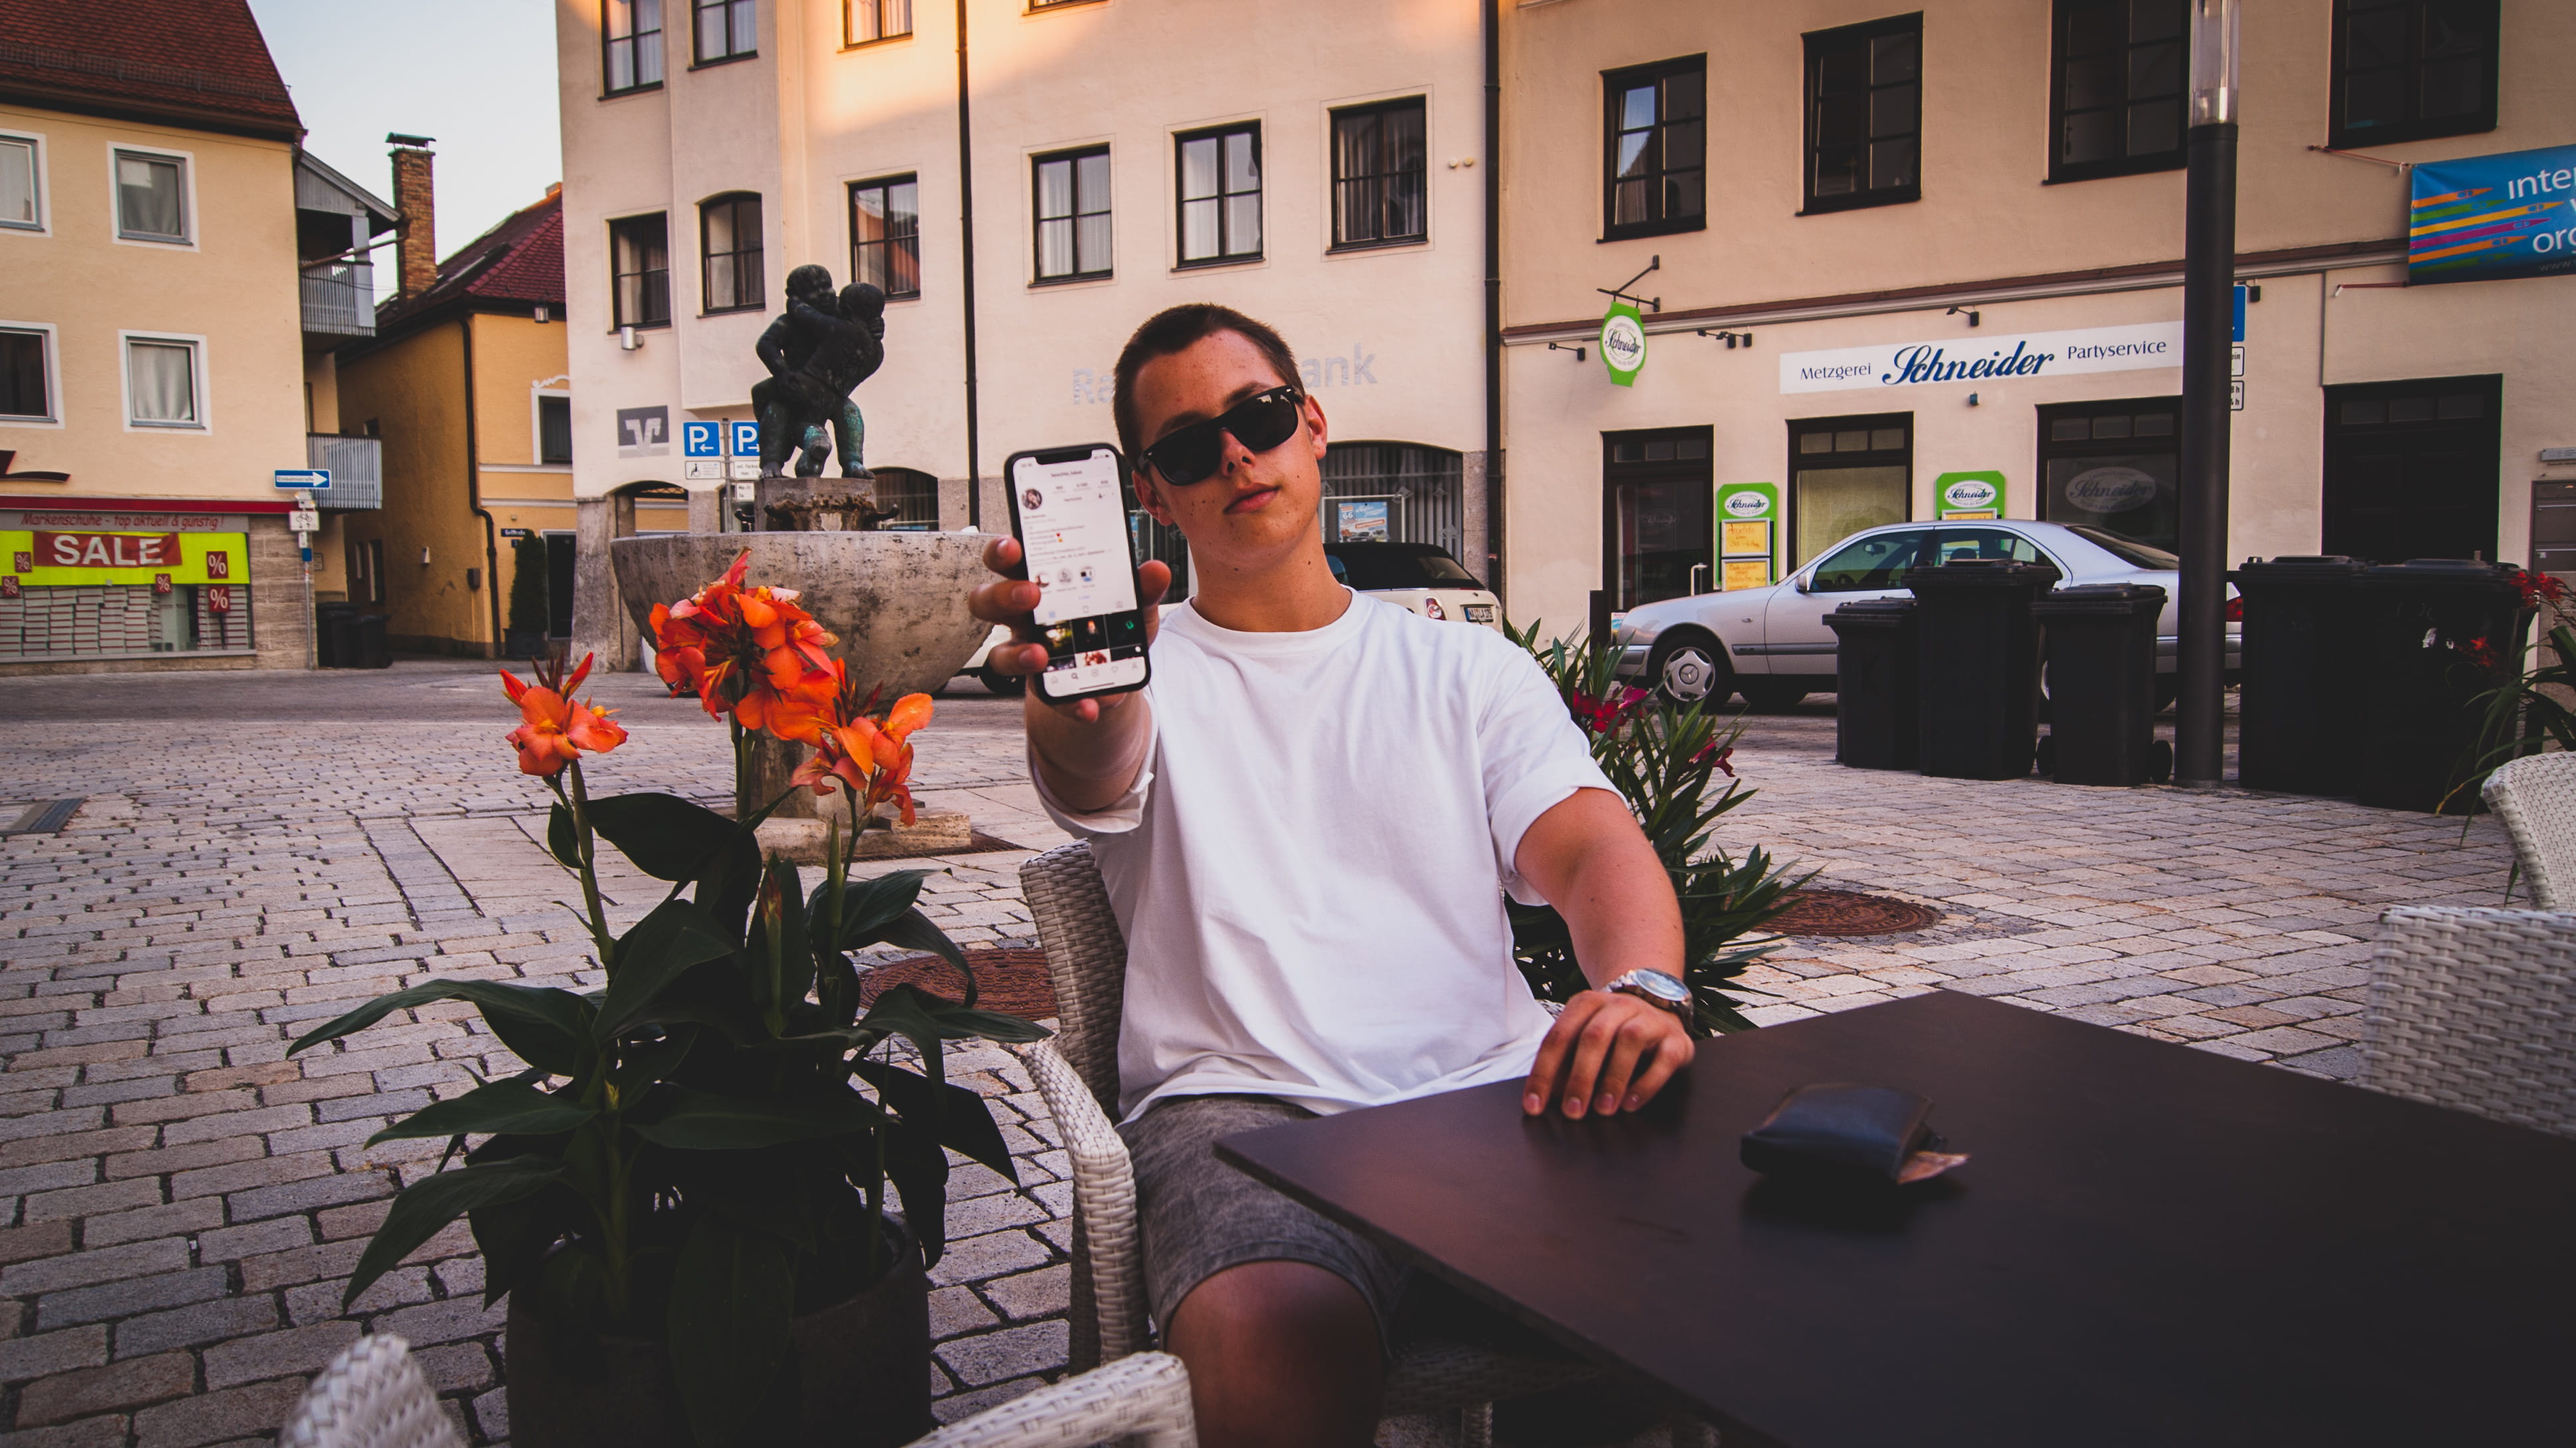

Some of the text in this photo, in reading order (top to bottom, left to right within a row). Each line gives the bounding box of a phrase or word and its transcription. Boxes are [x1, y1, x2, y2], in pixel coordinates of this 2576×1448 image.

[2508, 167, 2576, 200] inte
[1605, 328, 1641, 354] Schneider
[1800, 340, 2167, 385] Metzgerei Schneider Partyservice
[689, 426, 709, 452] P
[738, 426, 757, 452] P
[1947, 488, 1993, 498] Schneider
[2069, 479, 2153, 498] Schneider
[1726, 498, 1767, 509] Schneider
[21, 512, 102, 526] Markenschuhe
[114, 515, 130, 528] top
[134, 515, 168, 527] aktuell
[54, 535, 164, 565] SALE
[208, 554, 227, 575] %
[210, 589, 229, 609] %
